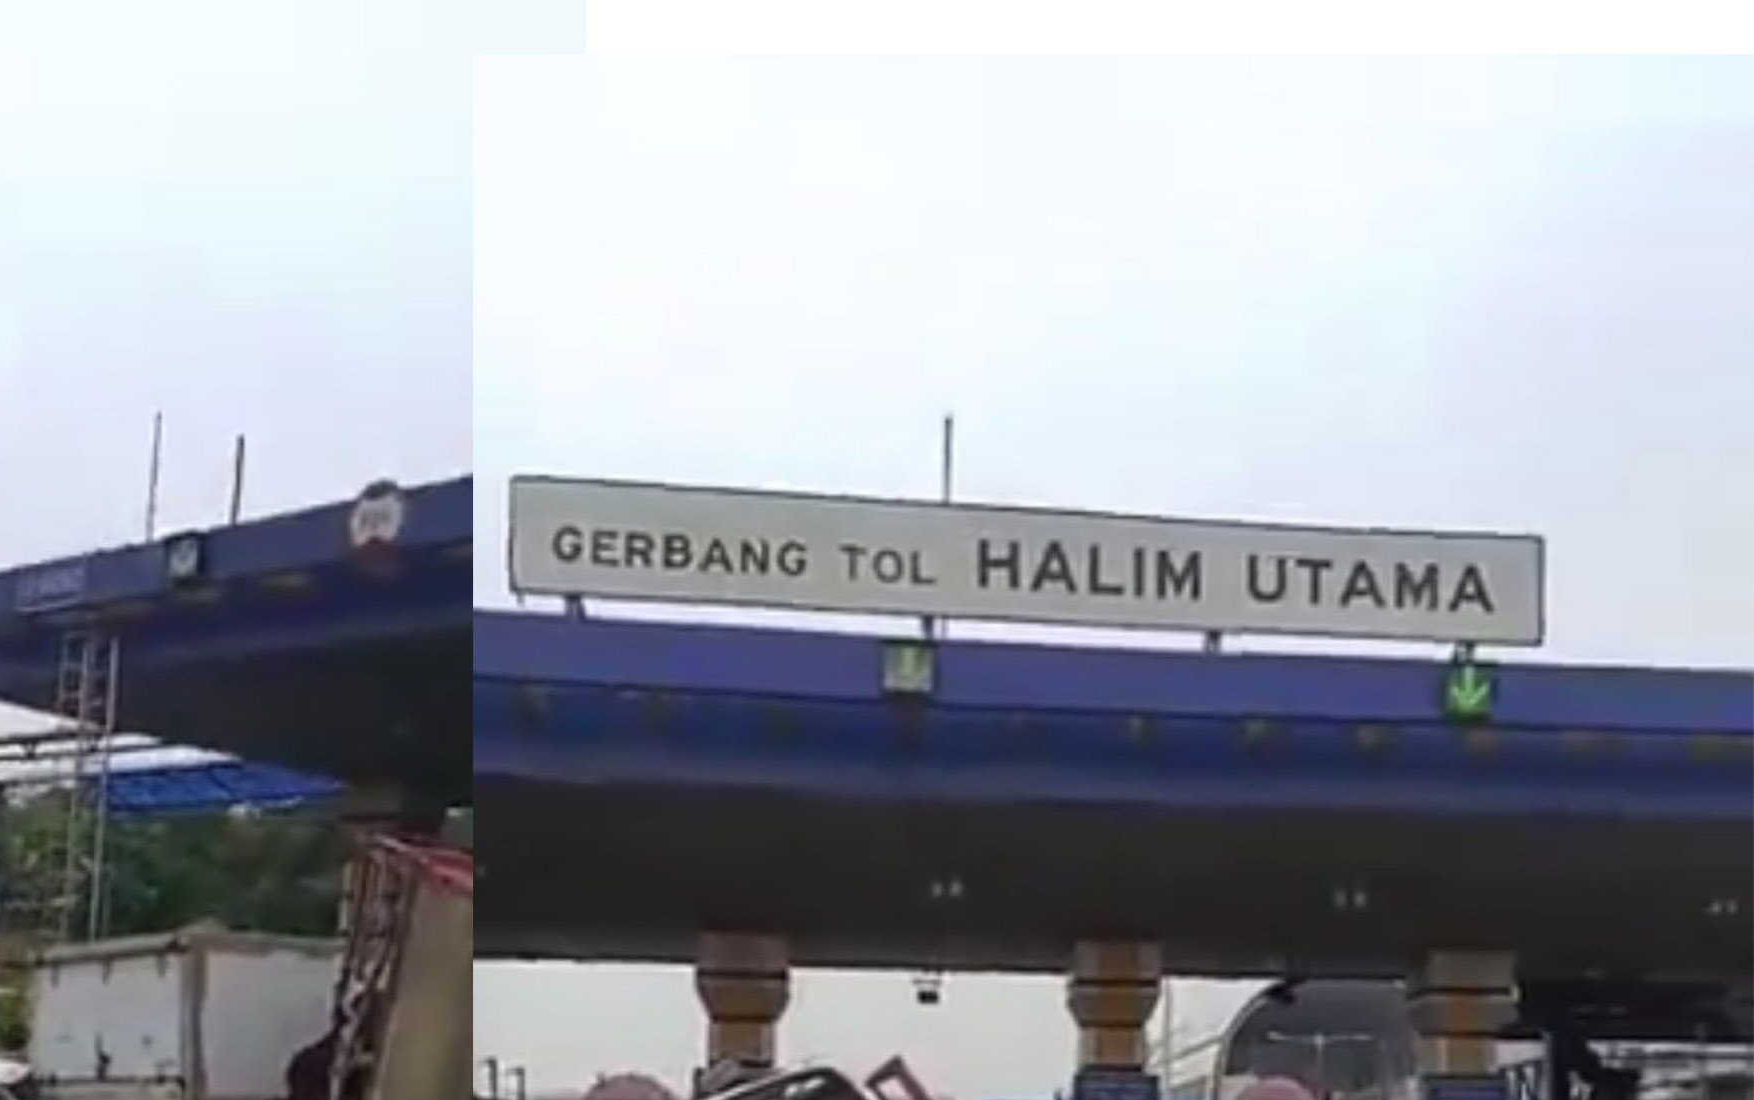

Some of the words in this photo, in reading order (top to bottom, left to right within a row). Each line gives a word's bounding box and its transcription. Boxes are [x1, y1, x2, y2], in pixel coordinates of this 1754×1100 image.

[551, 526, 809, 578] GERBANG
[840, 546, 937, 587] TOL
[976, 539, 1203, 601] HALIM
[1248, 557, 1494, 615] UTAMA
